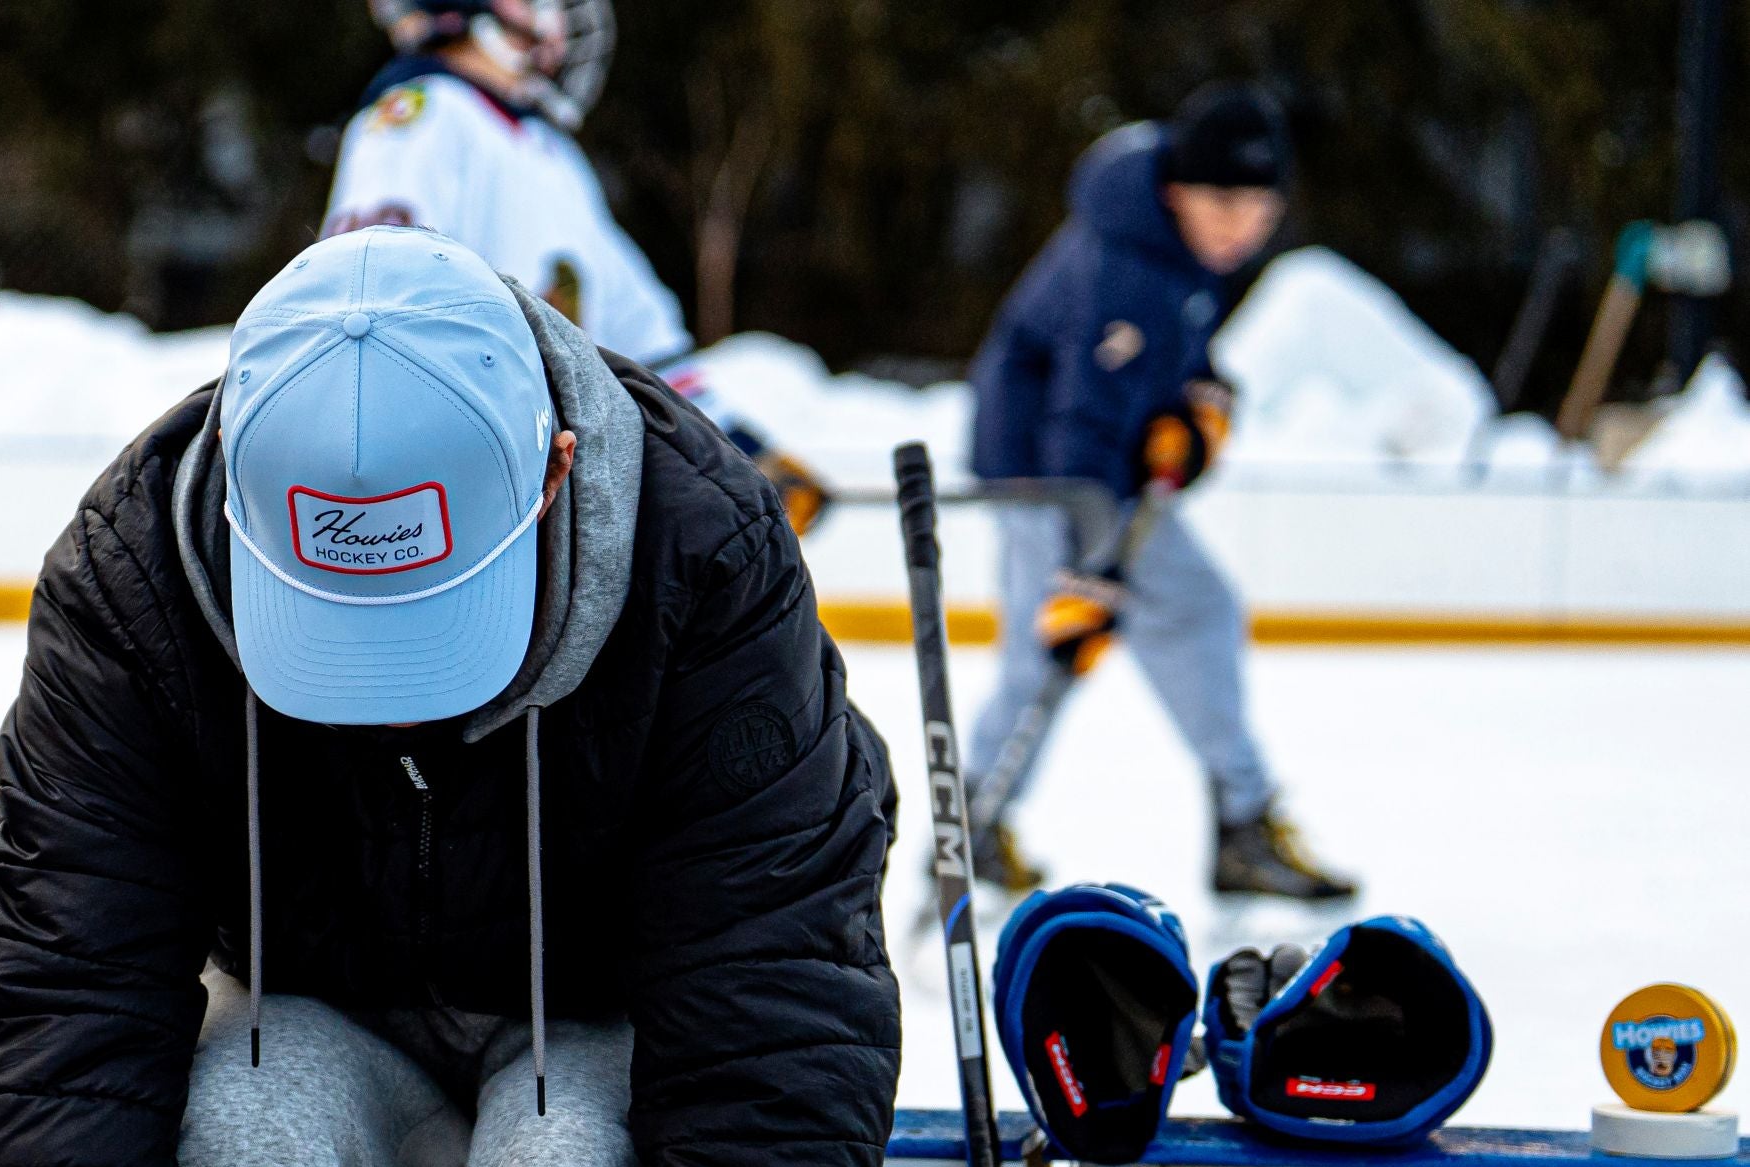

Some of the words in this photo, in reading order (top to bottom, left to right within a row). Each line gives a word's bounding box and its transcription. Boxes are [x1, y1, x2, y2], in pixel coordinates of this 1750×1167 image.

[312, 510, 423, 546] Howies
[315, 546, 388, 565] HOCKEY
[394, 545, 424, 561] CO.
[925, 720, 968, 877] CCM
